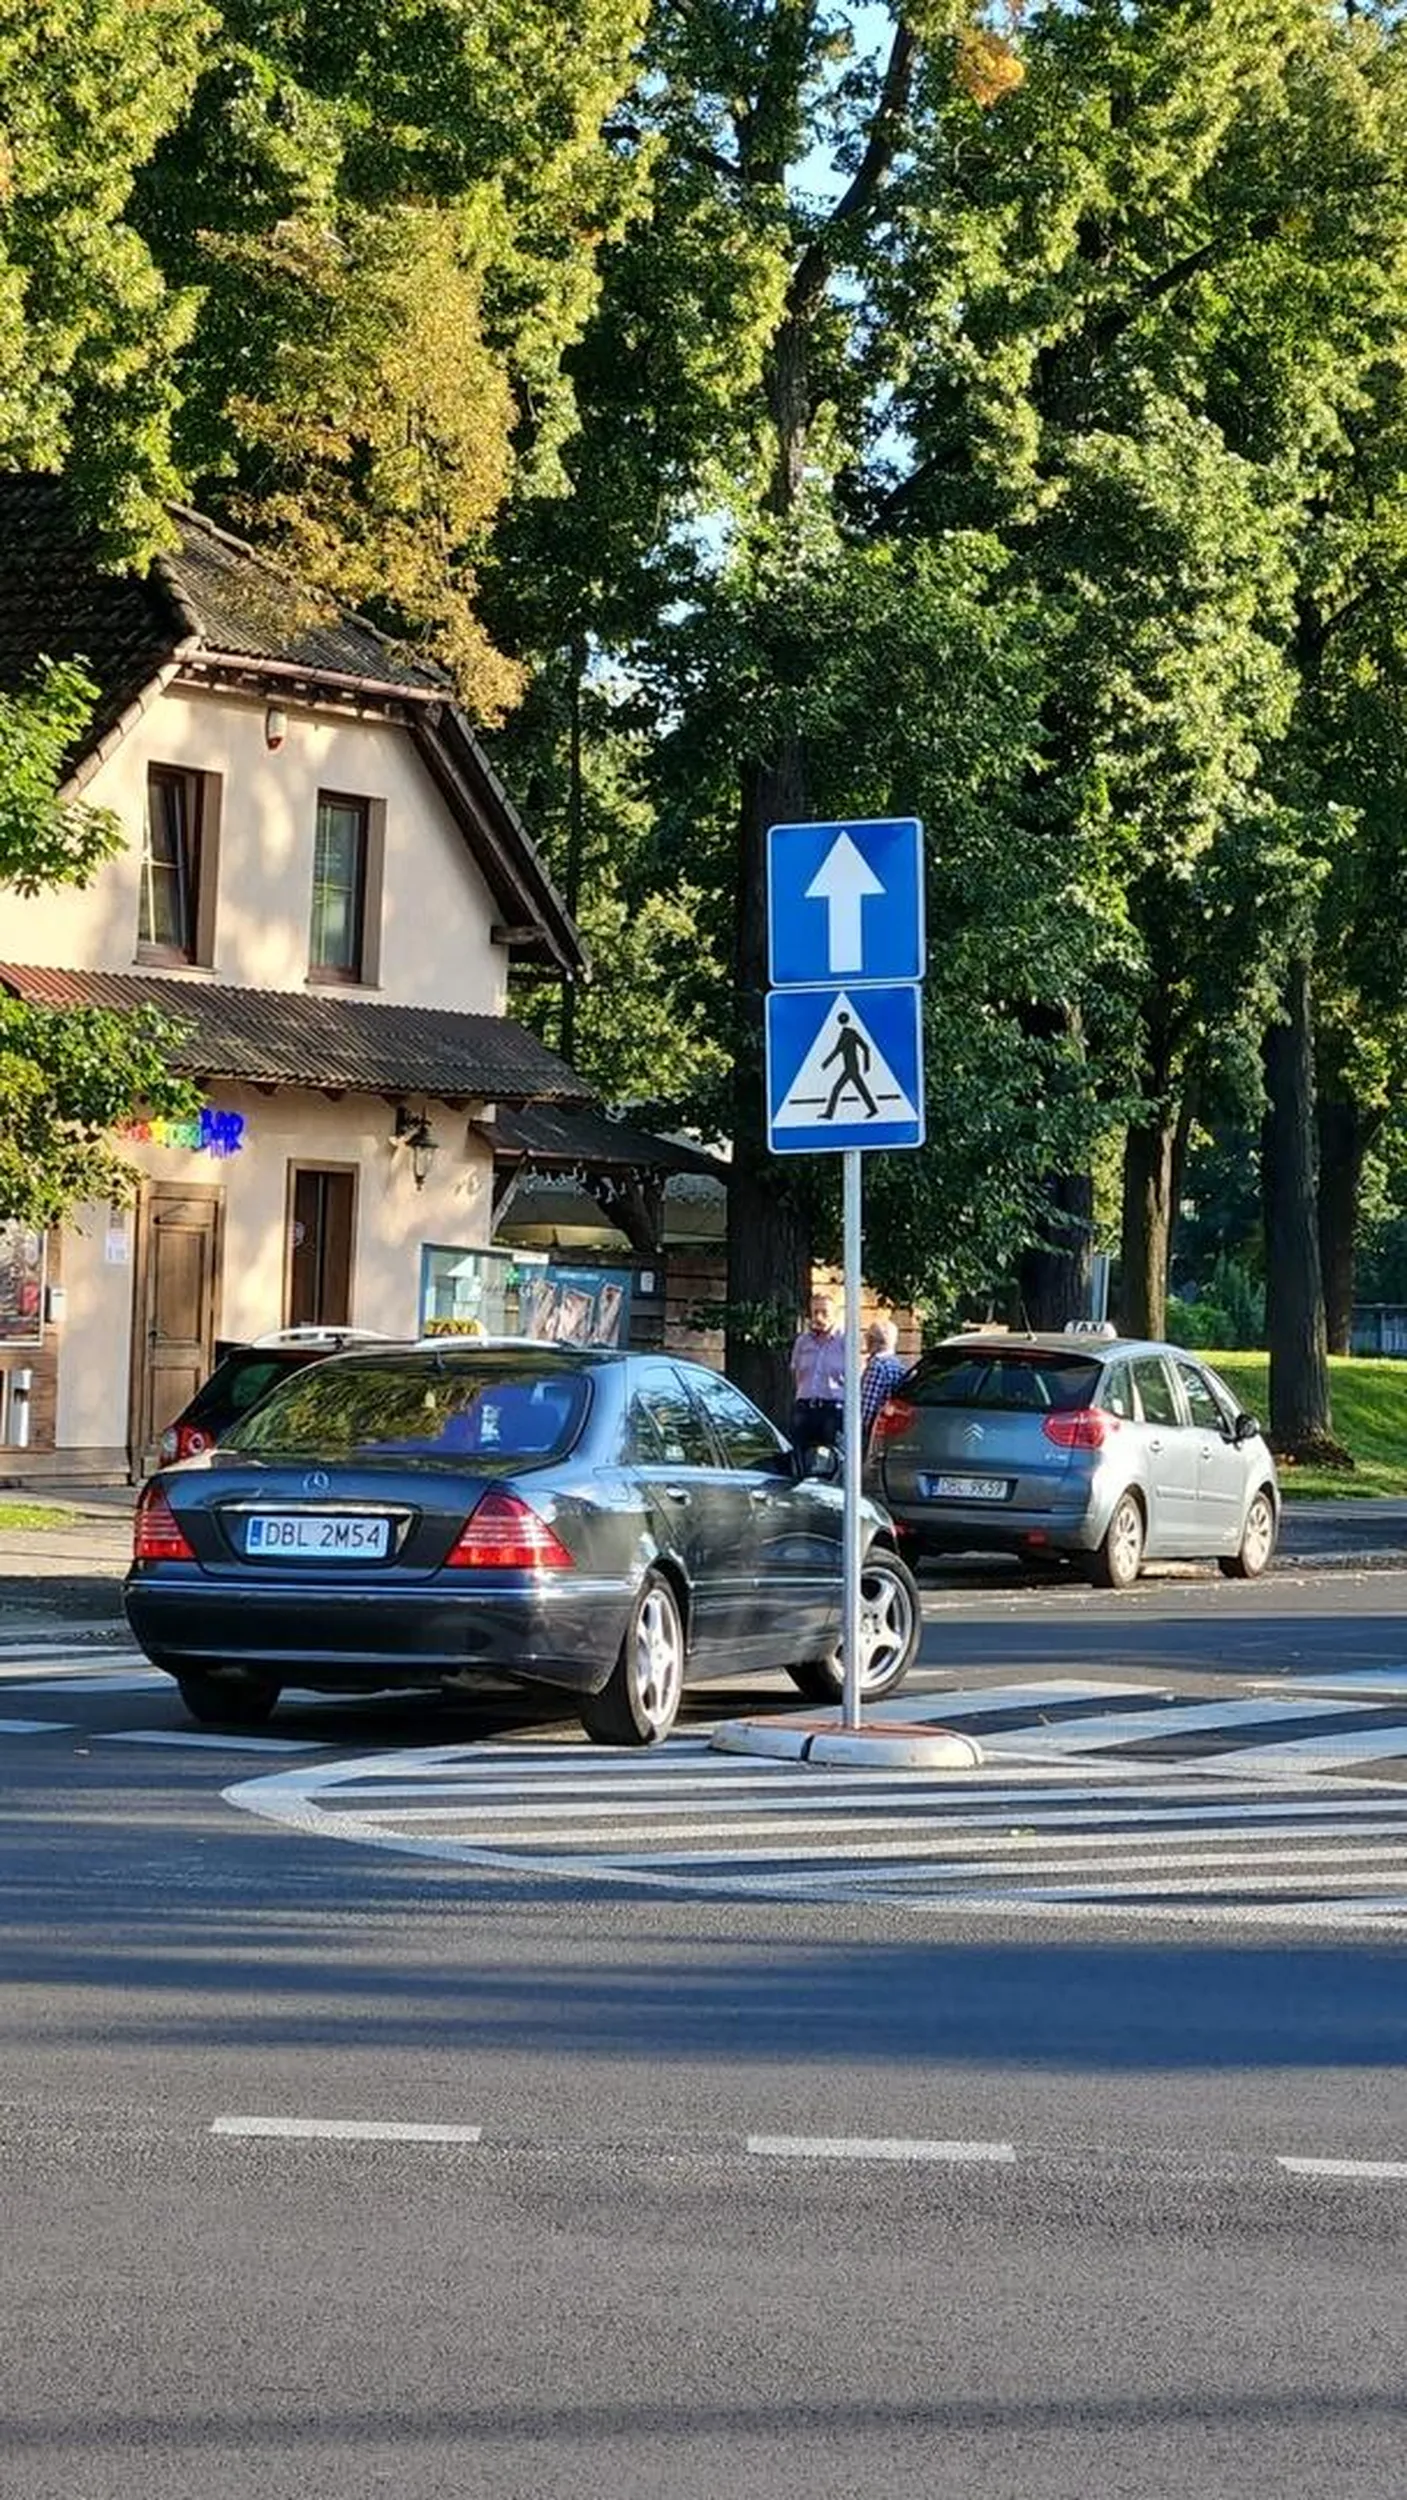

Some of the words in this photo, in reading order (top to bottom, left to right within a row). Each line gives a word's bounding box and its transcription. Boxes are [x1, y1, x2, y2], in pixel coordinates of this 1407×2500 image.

[430, 1320, 472, 1335] TAXI
[1071, 1320, 1105, 1332] TAXI
[265, 1522, 310, 1547] DBL
[319, 1523, 380, 1548] 2M54
